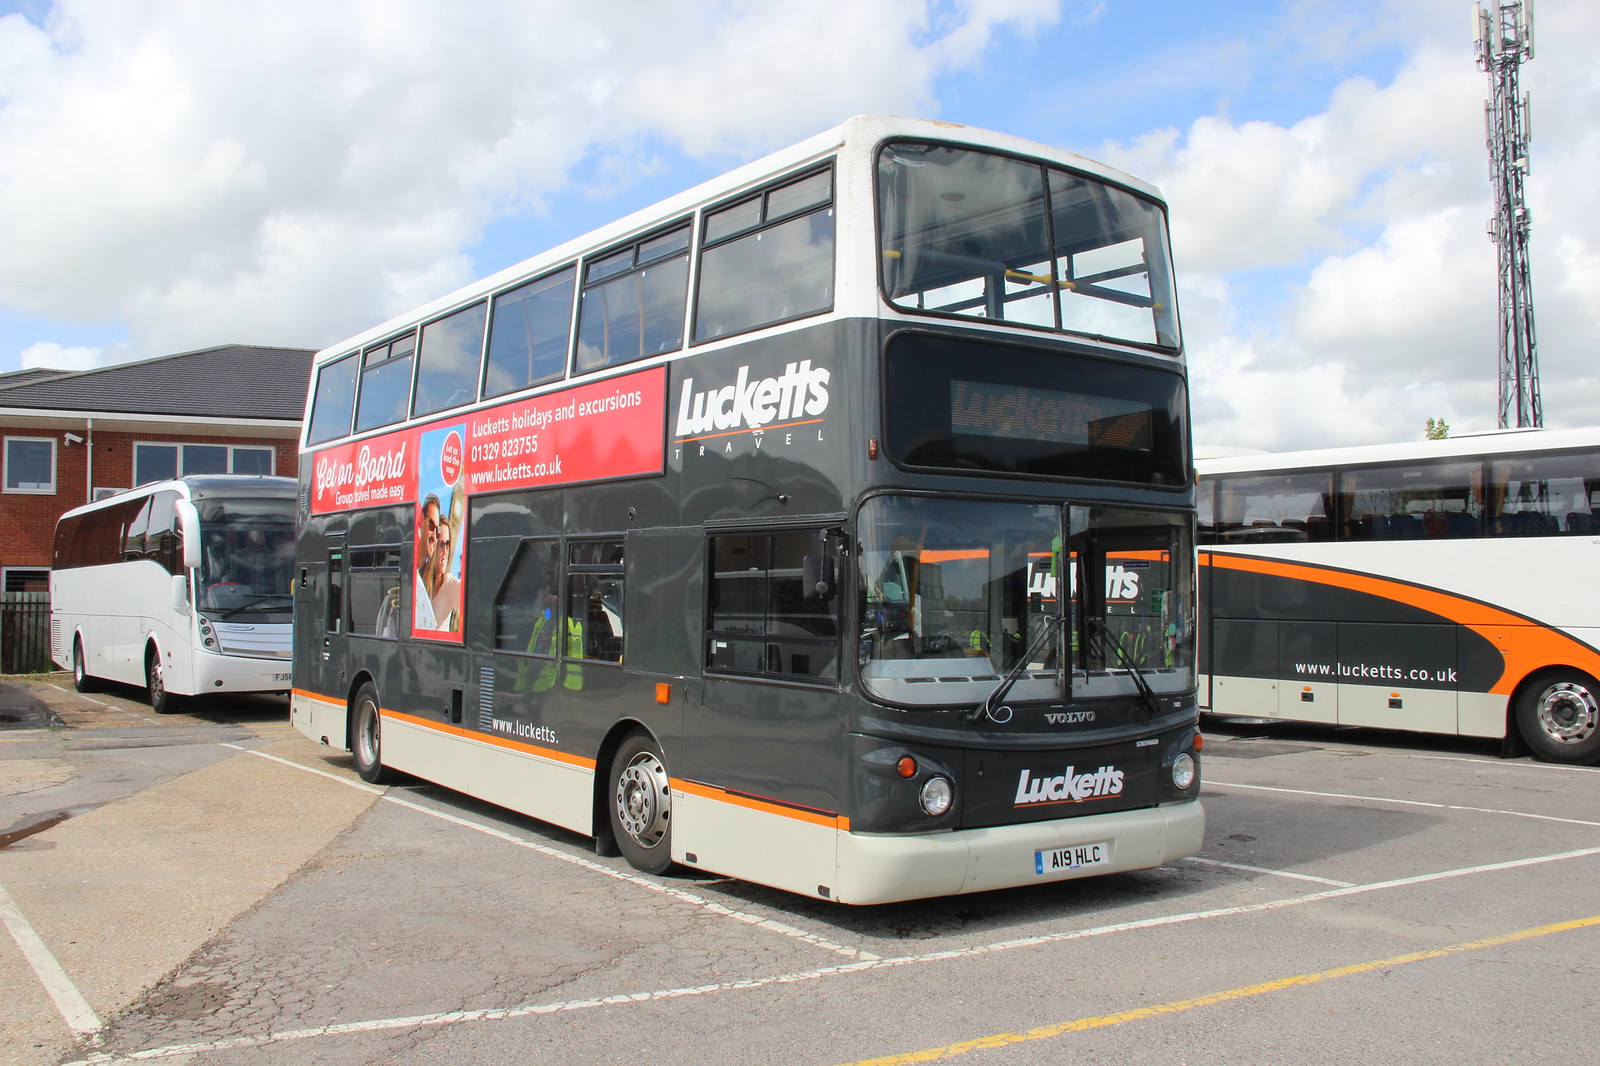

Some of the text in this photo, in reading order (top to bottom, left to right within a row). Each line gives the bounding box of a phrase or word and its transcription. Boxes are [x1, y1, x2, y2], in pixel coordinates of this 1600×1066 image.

[676, 359, 831, 437] Lucketts
[472, 389, 642, 438] Lucketts holidays and excursions
[471, 434, 538, 462] 01329 823755
[316, 441, 406, 501] Get on Board
[471, 454, 563, 485] www.lucketts.co.uk
[335, 482, 405, 507] Group travel made easy
[1295, 662, 1458, 683] www.lucketts.co.uk
[492, 717, 560, 745] www.lucketts.
[1044, 710, 1096, 725] VOLVO
[1014, 765, 1125, 804] Lucketts
[1052, 845, 1101, 868] A19 HLC
